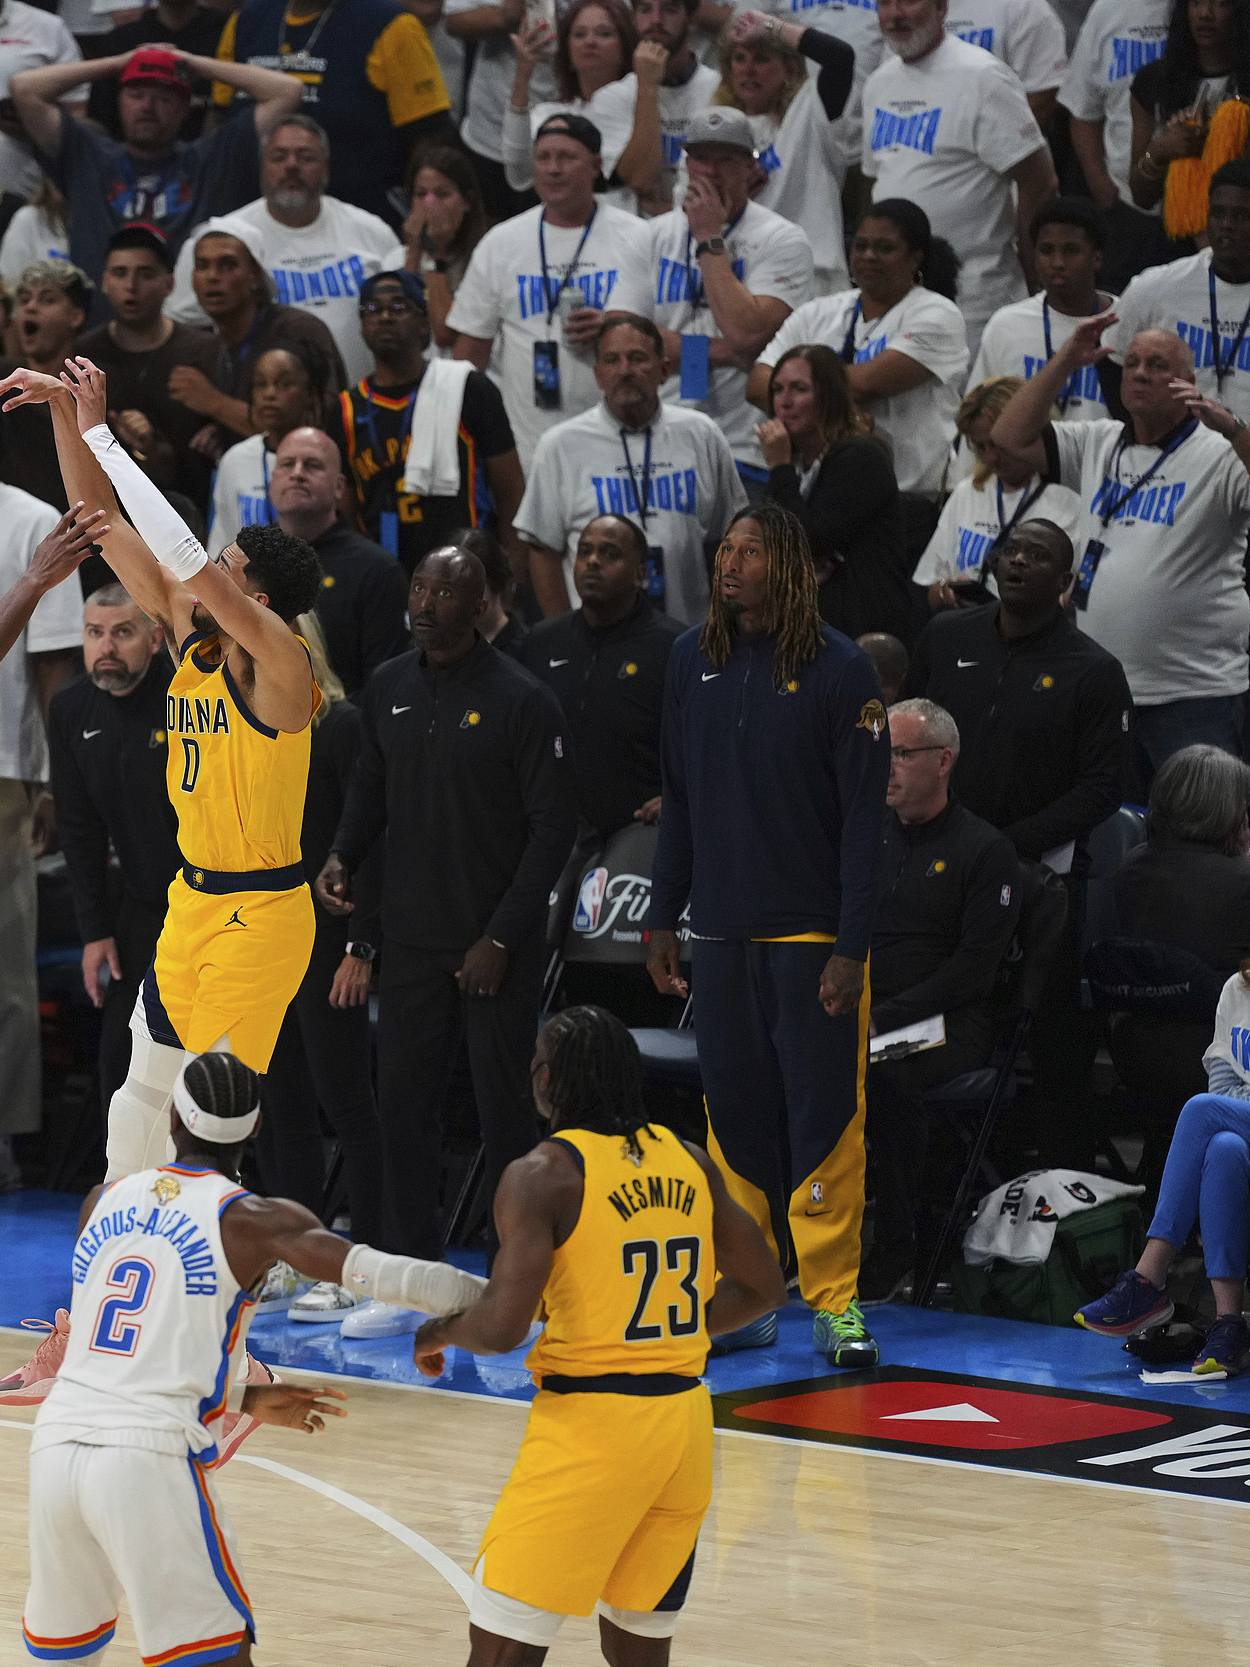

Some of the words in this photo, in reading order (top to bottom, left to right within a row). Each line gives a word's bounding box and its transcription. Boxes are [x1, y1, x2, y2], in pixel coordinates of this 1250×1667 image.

[180, 737, 201, 794] 0
[607, 1175, 696, 1223] NESMITH
[89, 1255, 156, 1358] 2
[622, 1234, 702, 1344] 23
